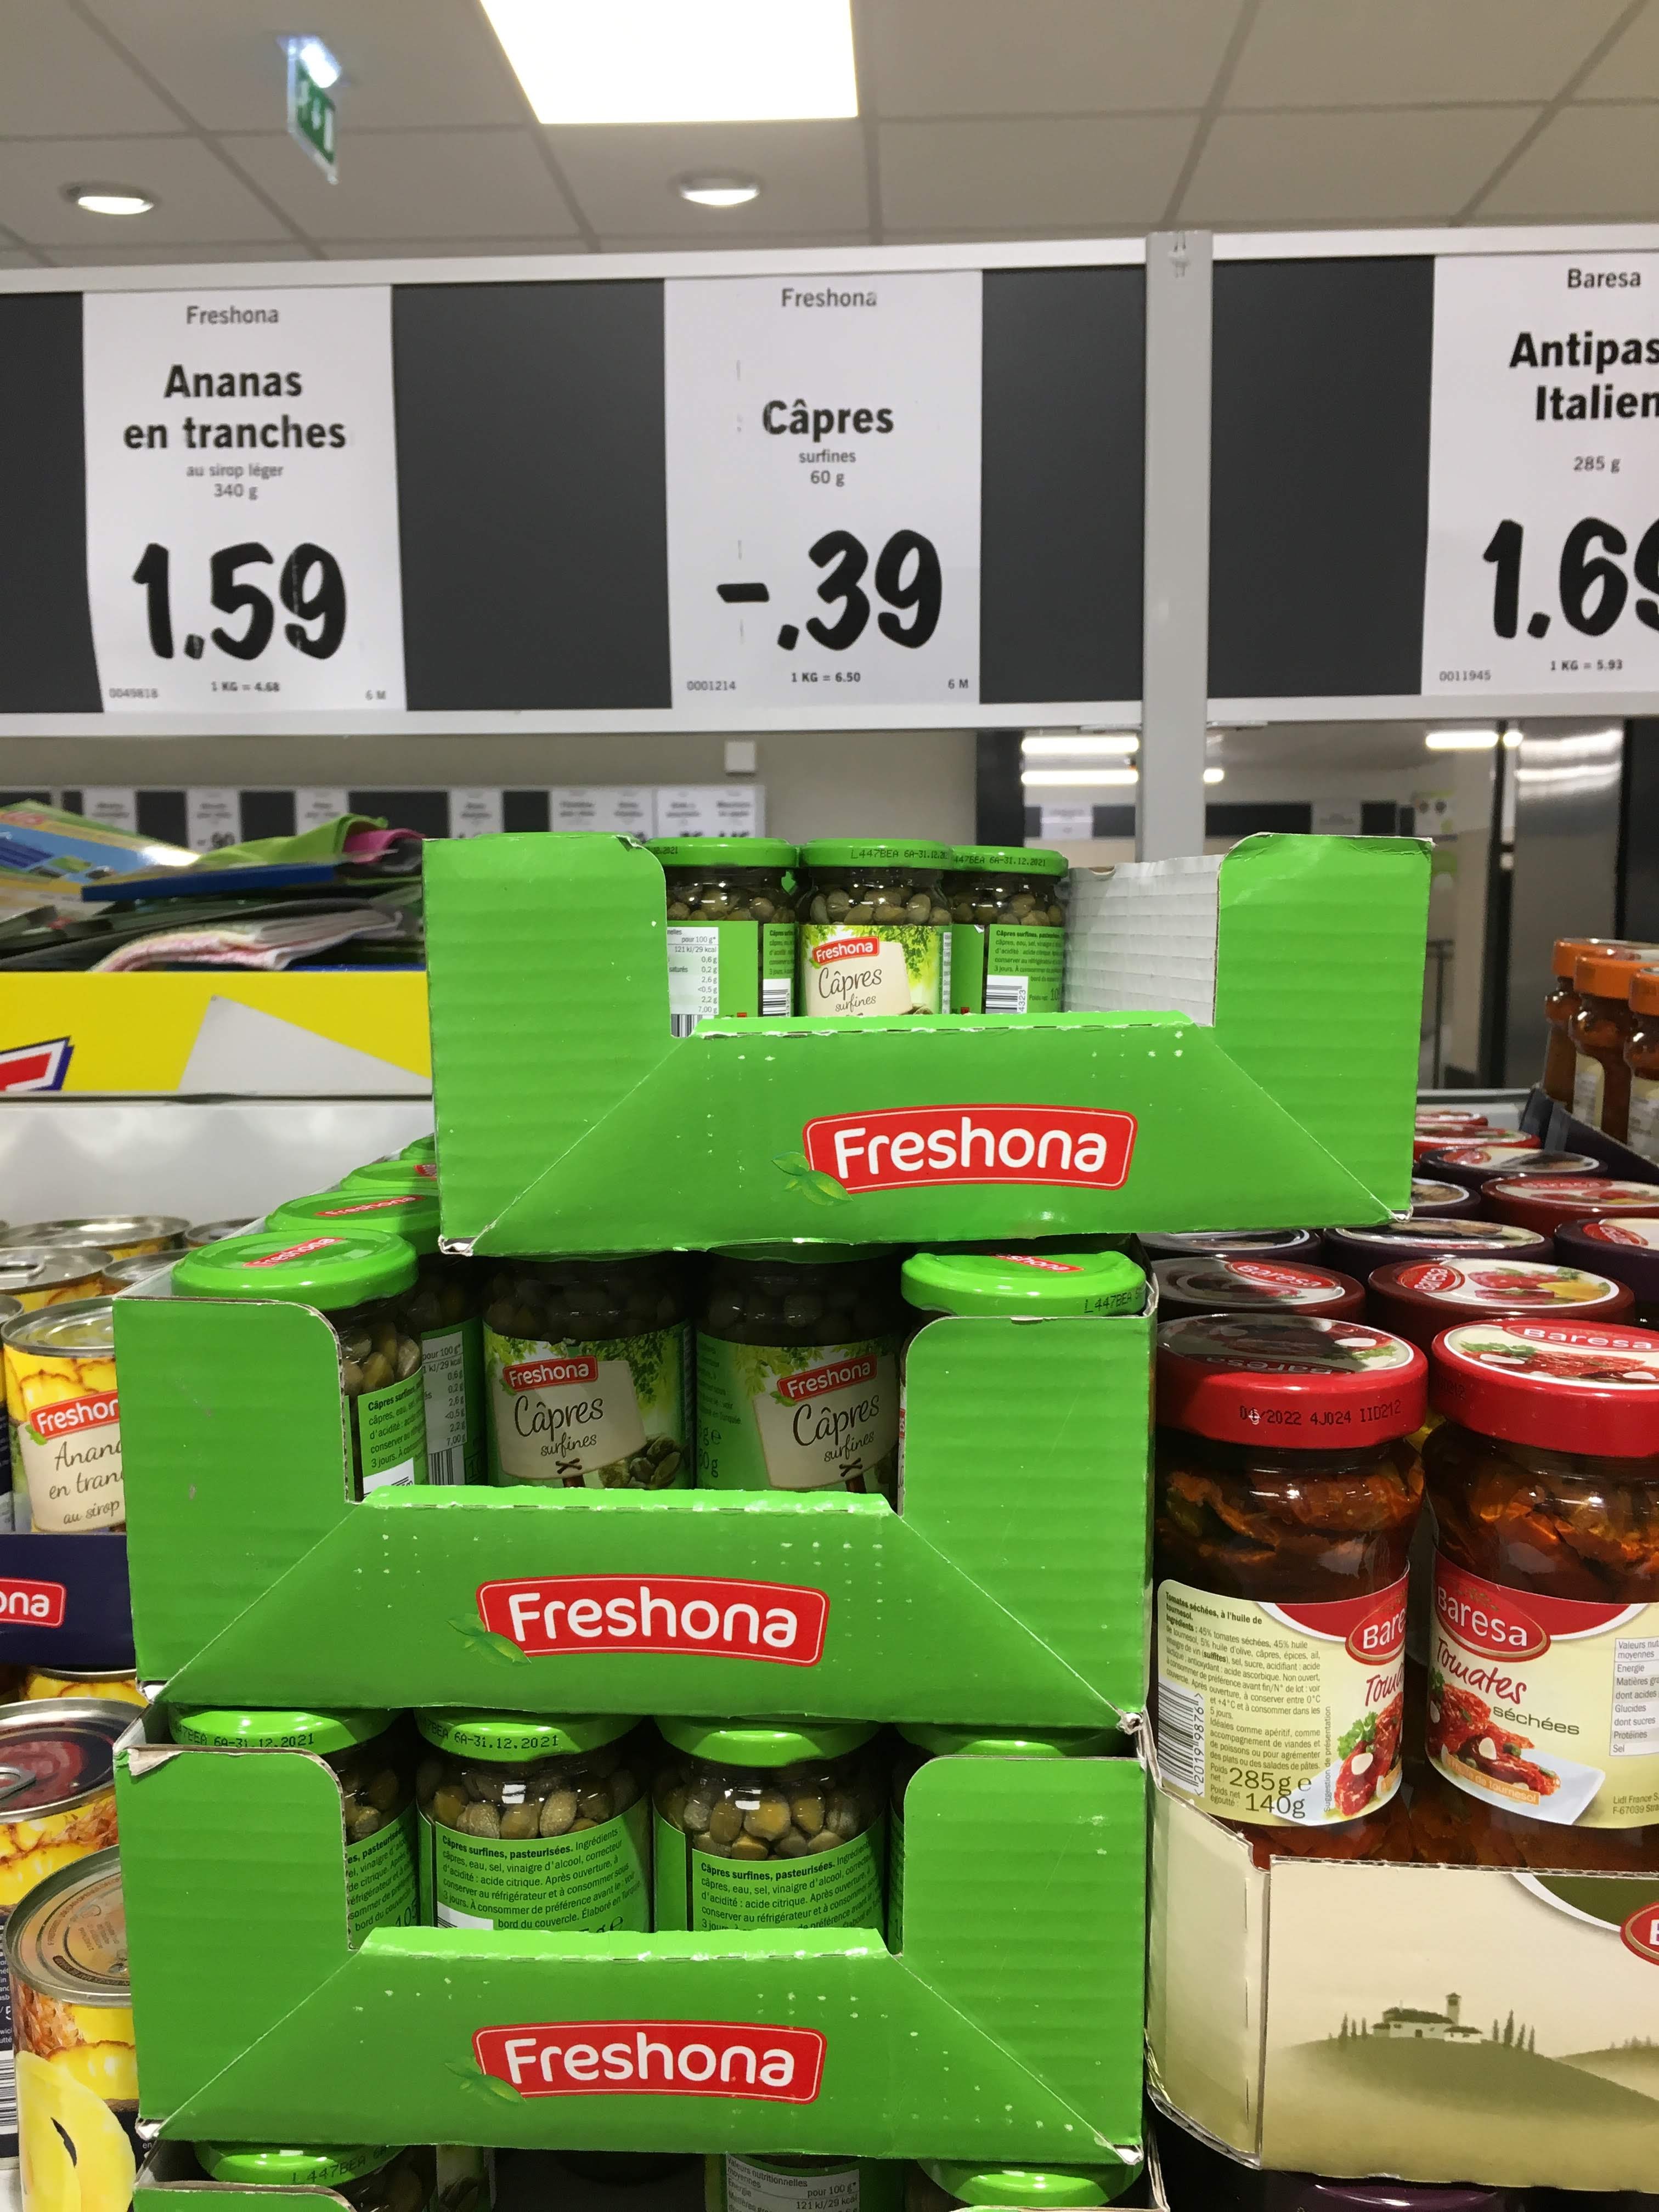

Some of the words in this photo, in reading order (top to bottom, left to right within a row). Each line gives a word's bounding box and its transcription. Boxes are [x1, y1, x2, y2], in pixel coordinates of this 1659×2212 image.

[1567, 268, 1641, 288] Baresa
[781, 288, 877, 308] Freshona
[187, 306, 279, 325] Freshona
[1509, 331, 1659, 374] Antipas
[164, 364, 302, 398] Ananas
[1536, 385, 1659, 420] Italien
[763, 399, 894, 442] Câpres
[123, 422, 167, 449] en
[183, 415, 346, 449] tranches
[799, 449, 856, 463] surfines
[1573, 455, 1605, 471] 285
[1611, 458, 1620, 473] g
[187, 466, 204, 477] au
[209, 464, 244, 480] sirop
[249, 463, 284, 480] léger
[811, 470, 831, 484] 60
[836, 472, 845, 487] g
[214, 483, 244, 497] 340
[249, 486, 258, 500] g
[132, 541, 347, 660] 1.59
[1551, 661, 1556, 671] 1
[1561, 661, 1578, 671] KG
[1596, 659, 1623, 670] 5.93
[791, 673, 797, 682] 1
[802, 673, 817, 682] KG
[835, 672, 860, 682] 6.50
[948, 679, 955, 689] 6
[959, 679, 968, 689] M
[1439, 670, 1491, 681] 0011945
[211, 682, 217, 691] 1
[222, 682, 238, 691] KG
[365, 690, 373, 700] 6
[687, 681, 736, 691] 0001214
[816, 942, 873, 963] Freshona
[819, 967, 883, 1001] Câpres
[835, 995, 876, 1012] surfines
[834, 1117, 1107, 1180] Freshona
[1237, 1264, 1322, 1288] Baresa
[1524, 1328, 1651, 1349] Baresa
[509, 1363, 589, 1387] Freshona
[787, 1362, 870, 1397] Freshona
[368, 1398, 394, 1411] Câpres
[369, 1412, 394, 1426] câpres,
[515, 1395, 603, 1442] Câpres
[793, 1395, 879, 1446] Câpres
[370, 1435, 403, 1454] conserver
[540, 1432, 597, 1458] surfines
[824, 1431, 874, 1462] surfines
[378, 1453, 397, 1468] jours.
[49, 1485, 70, 1499] en
[64, 1513, 82, 1524] au
[86, 1500, 120, 1519] sirop
[0, 1590, 49, 1617] na
[1166, 1592, 1188, 1608] Tomates
[1190, 1602, 1219, 1618] séchées,
[1166, 1603, 1193, 1620] tournesol.
[508, 1586, 798, 1647] Freshona
[1437, 1586, 1527, 1646] Baresa
[1214, 1631, 1239, 1643] tomates
[1618, 1641, 1646, 1649] Valeurs
[1256, 1650, 1281, 1659] câpres,
[1284, 1651, 1308, 1660] épices,
[1618, 1651, 1655, 1660] moyennes
[1266, 1661, 1297, 1670] acidifiant
[1436, 1637, 1527, 1705] Tomates
[1617, 1664, 1645, 1673] Energie
[1243, 1682, 1261, 1691] avant
[1616, 1678, 1648, 1686] Matières
[1251, 1695, 1284, 1703] conserver
[1634, 1690, 1657, 1699] acides
[1615, 1704, 1646, 1713] Glucides
[1493, 1706, 1579, 1735] séchées
[1633, 1717, 1656, 1725] sucres
[1236, 1725, 1262, 1735] comme
[1613, 1730, 1647, 1739] Protéines
[454, 1731, 558, 1749] 6A-31.12.2021
[1613, 1745, 1624, 1753] Sel
[1281, 1751, 1320, 1760] agrémenter
[1229, 1767, 1291, 1796] 285g
[1245, 1793, 1305, 1819] 140g
[1613, 1796, 1627, 1804] Lidl
[443, 1835, 467, 1852] Câpres
[469, 1847, 507, 1860] surfines,
[510, 1846, 573, 1860] pasteurisées.
[576, 1829, 618, 1850] Ingrédients
[507, 1863, 542, 1874] vinaigre
[545, 1855, 584, 1870] d'alcool,
[586, 1840, 622, 1862] correcteur
[506, 1878, 543, 1888] citrique.
[545, 1873, 571, 1886] Après
[573, 1860, 612, 1879] ouverture,
[701, 1863, 730, 1877] Câpres
[732, 1871, 773, 1881] surfines,
[776, 1862, 835, 1881] pasteurisées.
[492, 1891, 546, 1903] réfrigérateur
[567, 1874, 614, 1894] consommer
[732, 1886, 752, 1895] eau,
[754, 1886, 770, 1895] sel,
[810, 1870, 844, 1888] d'alcool,
[505, 2032, 794, 2087] Freshona
[807, 2188, 826, 2198] pour
[830, 2184, 845, 2193] 100
